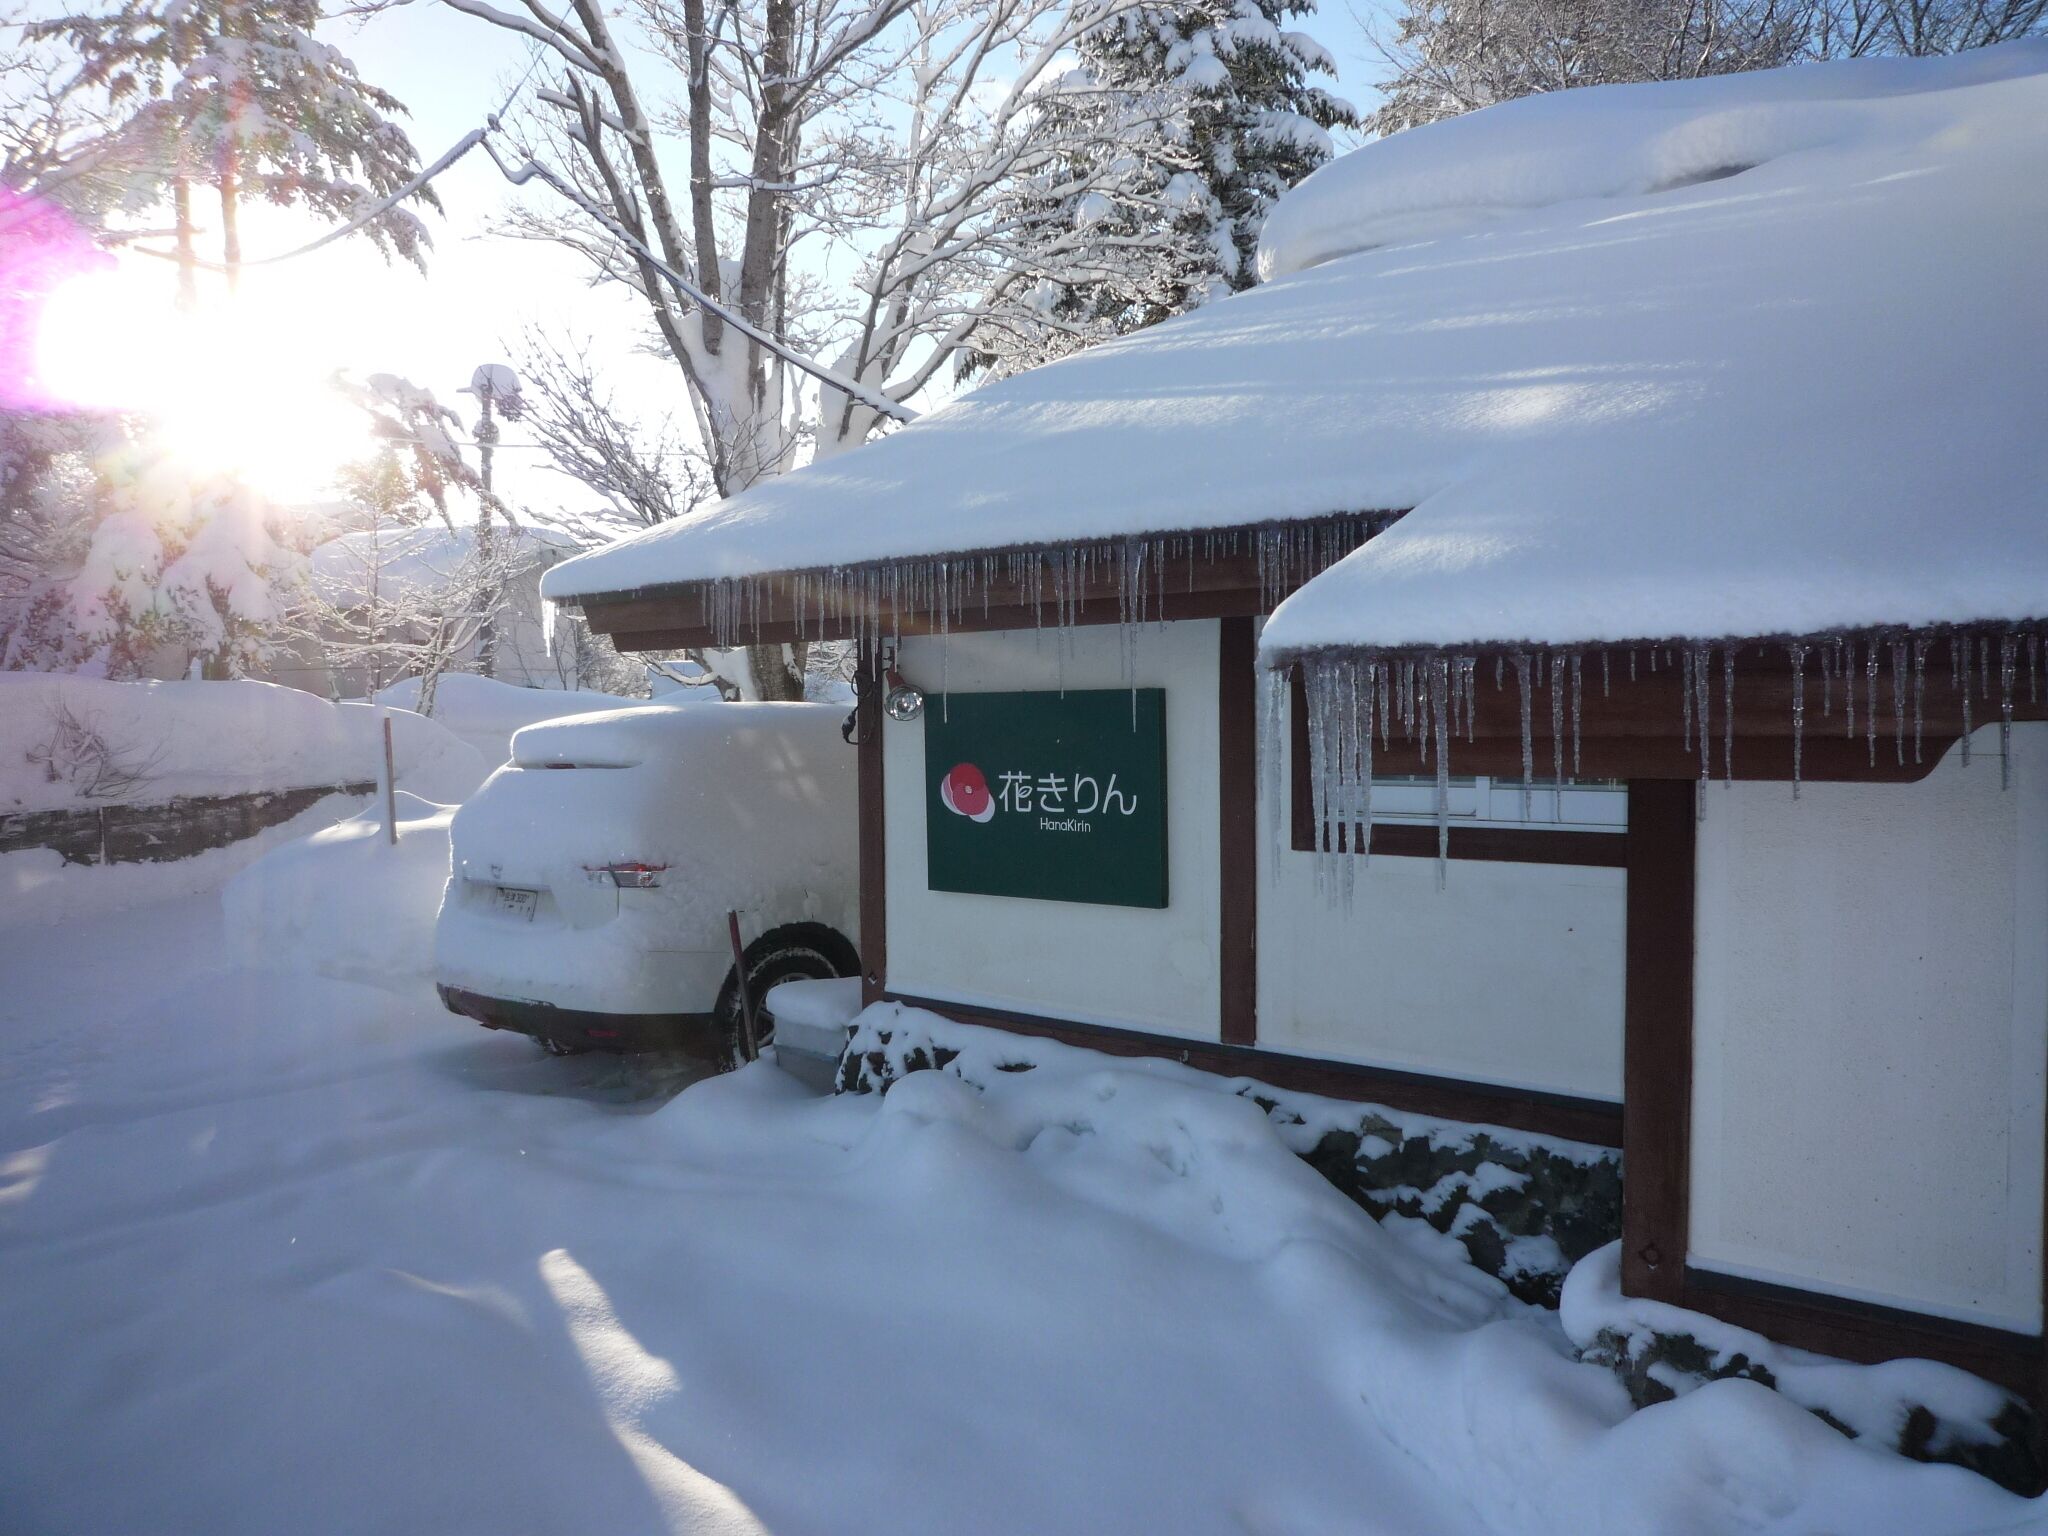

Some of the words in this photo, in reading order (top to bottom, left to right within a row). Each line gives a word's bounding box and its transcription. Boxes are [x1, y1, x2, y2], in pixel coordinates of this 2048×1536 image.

[998, 770, 1137, 815] 花きりん
[1039, 817, 1091, 833] HanaKirin
